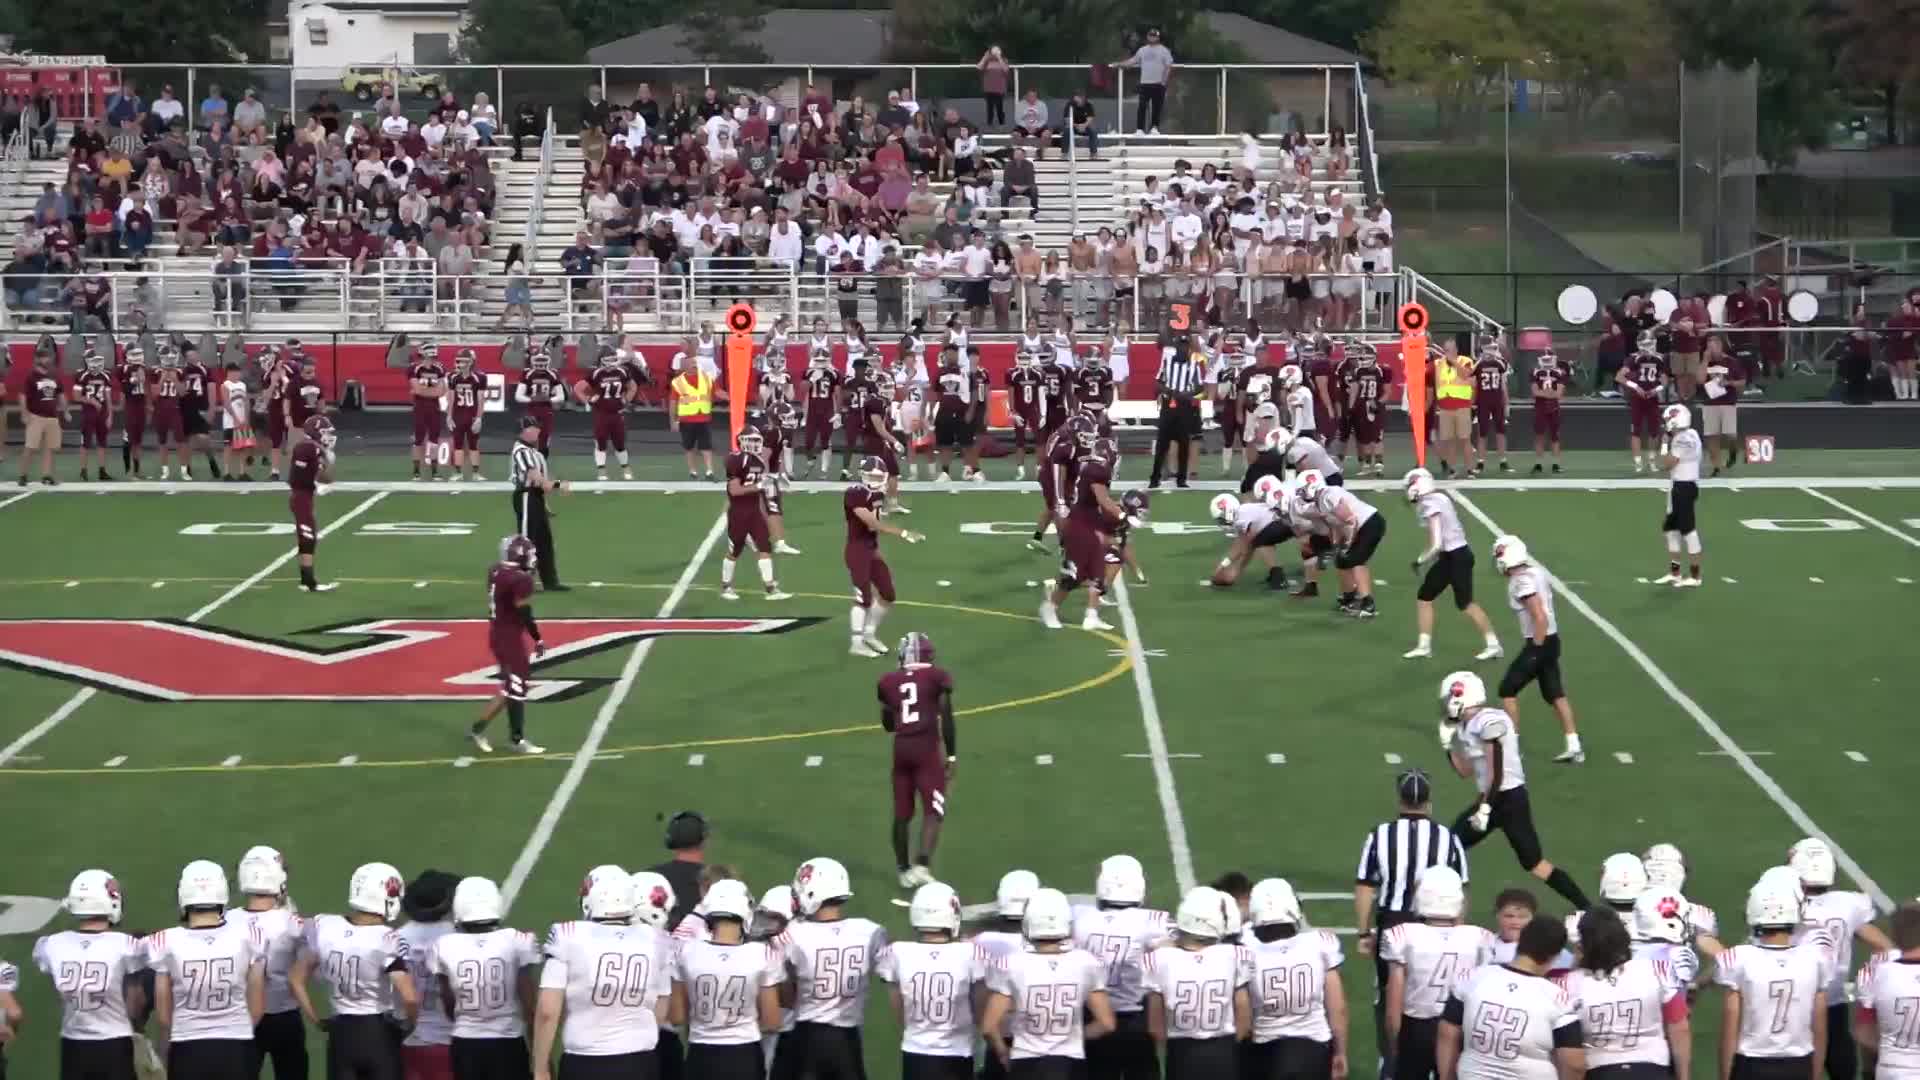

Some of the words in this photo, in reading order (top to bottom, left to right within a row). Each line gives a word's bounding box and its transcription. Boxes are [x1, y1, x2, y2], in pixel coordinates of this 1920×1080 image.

[1169, 303, 1192, 330] 3
[1748, 438, 1773, 462] 30
[899, 681, 920, 724] 2
[59, 960, 109, 1012] 22
[182, 956, 235, 1012] 75
[456, 957, 506, 1012] 38
[591, 952, 650, 1007] 60
[693, 973, 748, 1026] 84
[813, 945, 865, 1000] 56
[912, 971, 954, 1025] 18
[1262, 962, 1314, 1018] 50
[1428, 951, 1459, 1004] 4
[1025, 982, 1078, 1036] 55
[1174, 978, 1228, 1032] 26
[1470, 1000, 1530, 1060] 52
[1768, 978, 1794, 1034] 7
